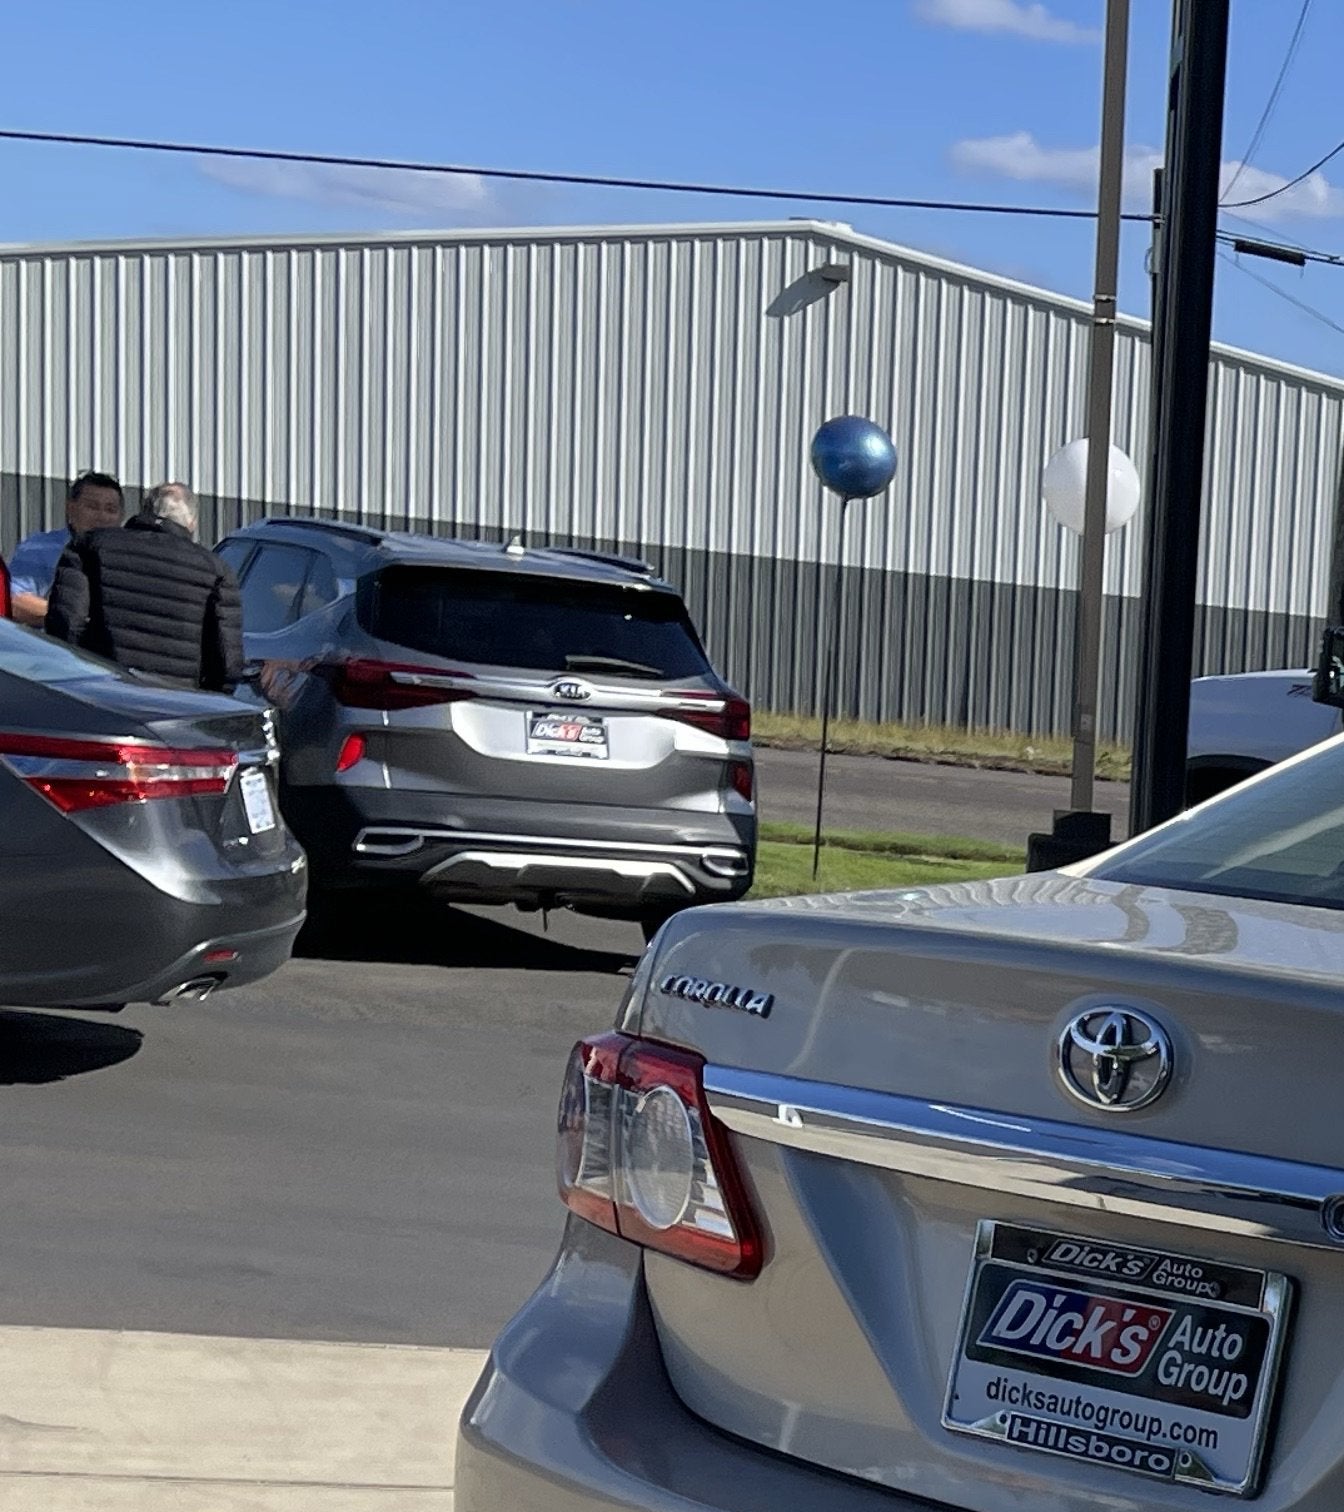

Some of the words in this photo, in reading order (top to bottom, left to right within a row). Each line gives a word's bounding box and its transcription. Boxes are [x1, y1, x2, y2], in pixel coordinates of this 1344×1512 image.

[661, 975, 775, 1018] COROLLA
[1051, 1242, 1145, 1275] Dick's
[1155, 1259, 1204, 1279] Auto
[1152, 1271, 1212, 1294] Group
[991, 1289, 1150, 1366] Dick's
[1168, 1315, 1244, 1361] Auto
[1157, 1349, 1248, 1406] Group
[986, 1377, 1218, 1449] dicksautogroup.com
[1011, 1416, 1171, 1472] Hillsboro
